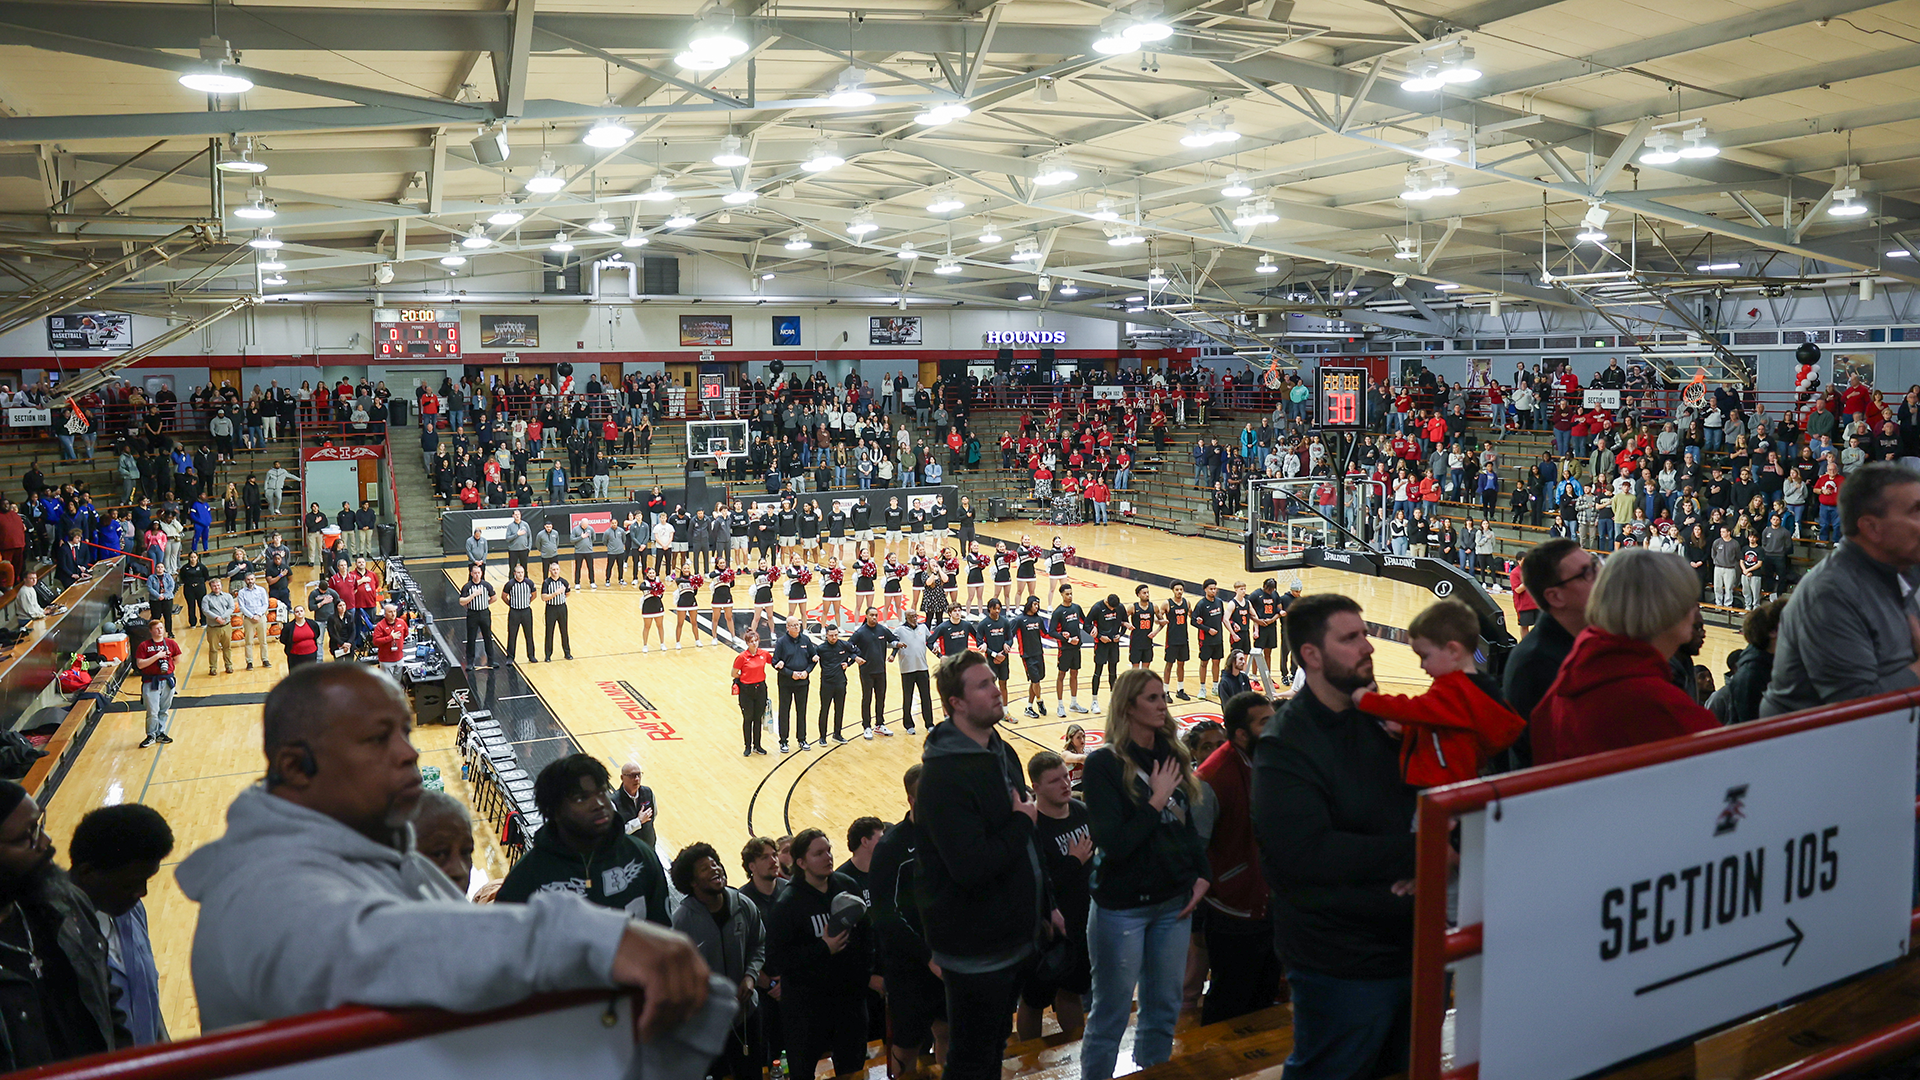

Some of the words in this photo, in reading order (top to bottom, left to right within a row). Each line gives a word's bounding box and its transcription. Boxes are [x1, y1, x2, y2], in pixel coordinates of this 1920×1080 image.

[401, 310, 434, 321] 20:00
[390, 328, 398, 340] 0
[417, 330, 422, 339] 1
[447, 328, 456, 340] 0
[986, 330, 1066, 344] HOUNDS
[382, 344, 390, 354] 0
[395, 344, 403, 353] 4
[434, 344, 442, 353] 4
[448, 344, 457, 353] 0
[704, 384, 720, 398] 30
[1588, 396, 1606, 404] SECTION
[1328, 393, 1356, 423] 30
[1323, 551, 1351, 564] SPALDING
[1383, 556, 1417, 569] SPALDING
[1139, 619, 1151, 630] 20
[595, 680, 661, 720] SKILLMAN
[635, 721, 684, 741] RAY
[1599, 847, 1765, 962] SECTION
[1783, 825, 1839, 904] 105
